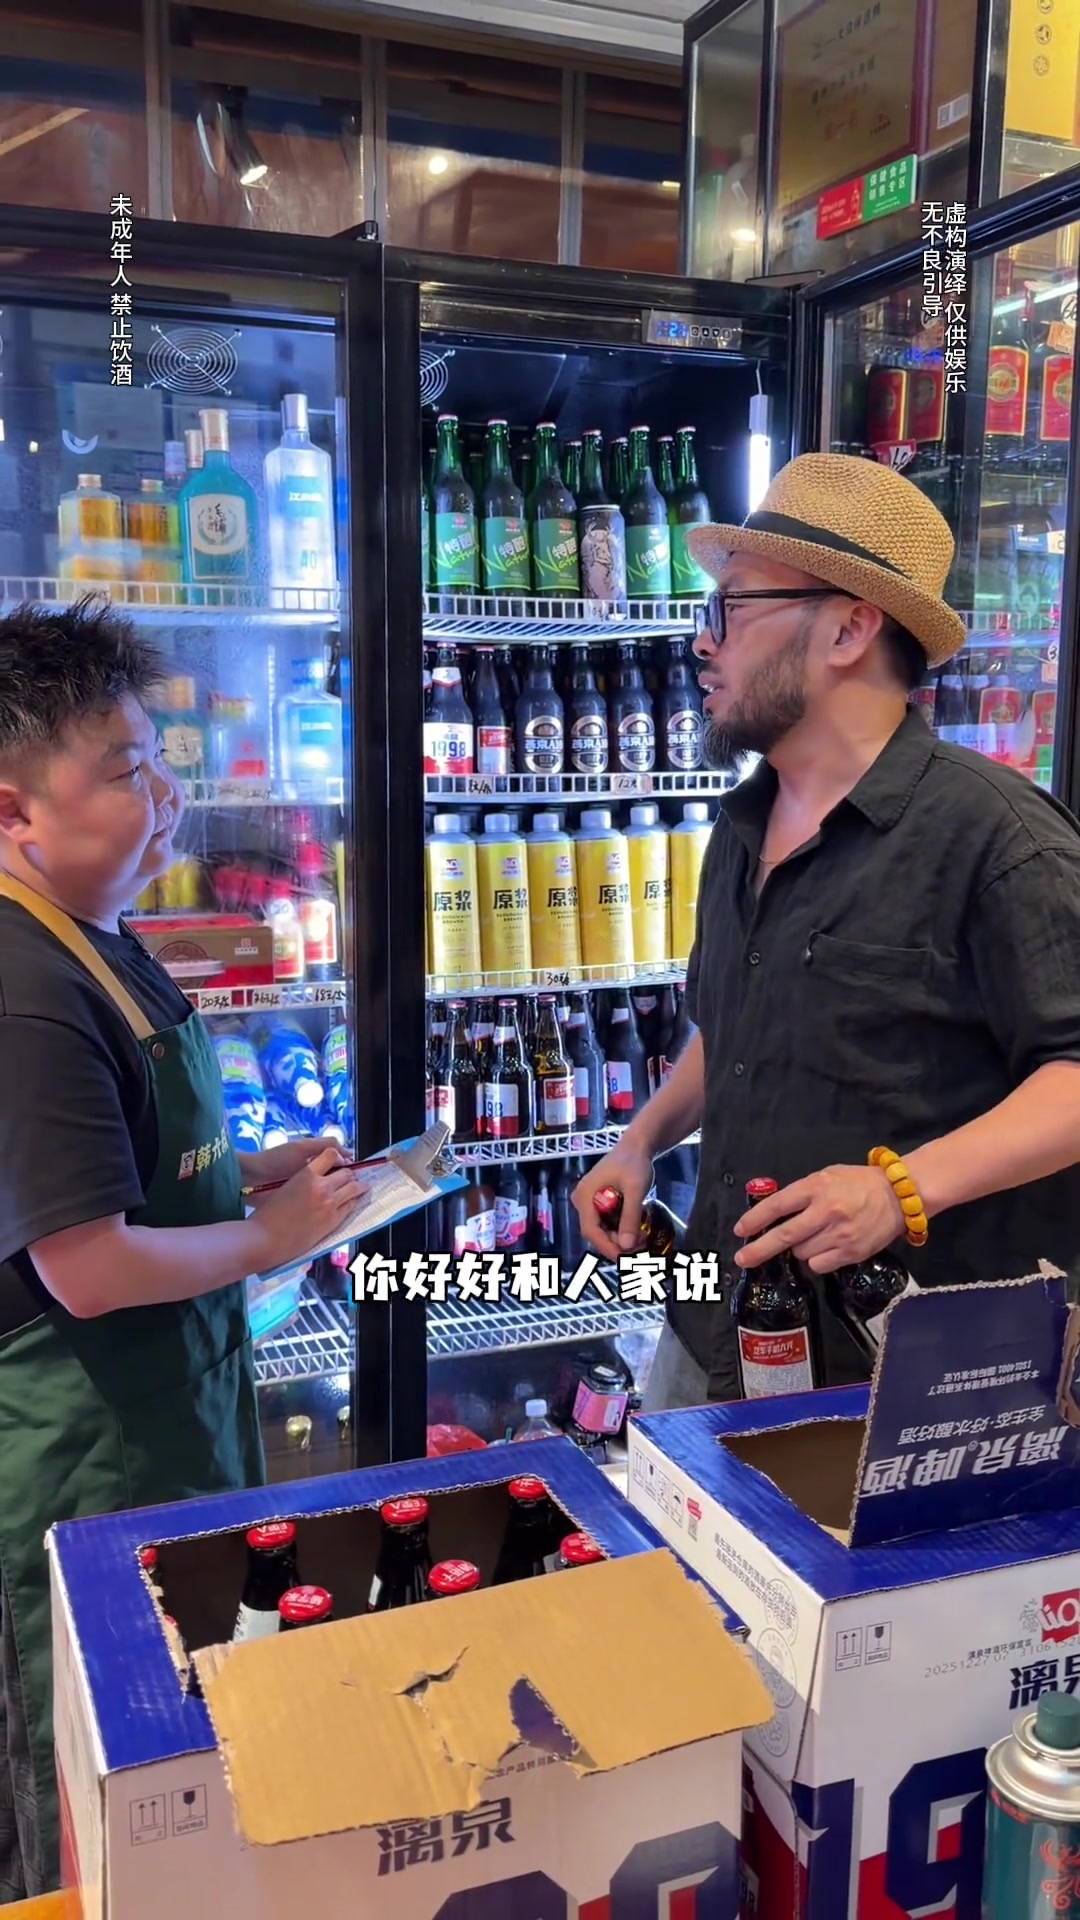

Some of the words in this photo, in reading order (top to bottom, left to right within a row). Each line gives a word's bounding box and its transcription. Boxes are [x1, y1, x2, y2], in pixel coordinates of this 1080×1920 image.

[432, 741, 466, 757] 1998
[433, 890, 472, 911] 原浆
[493, 888, 528, 910] 原浆
[547, 886, 578, 908] 原浆
[376, 1796, 516, 1876] 漓泉
